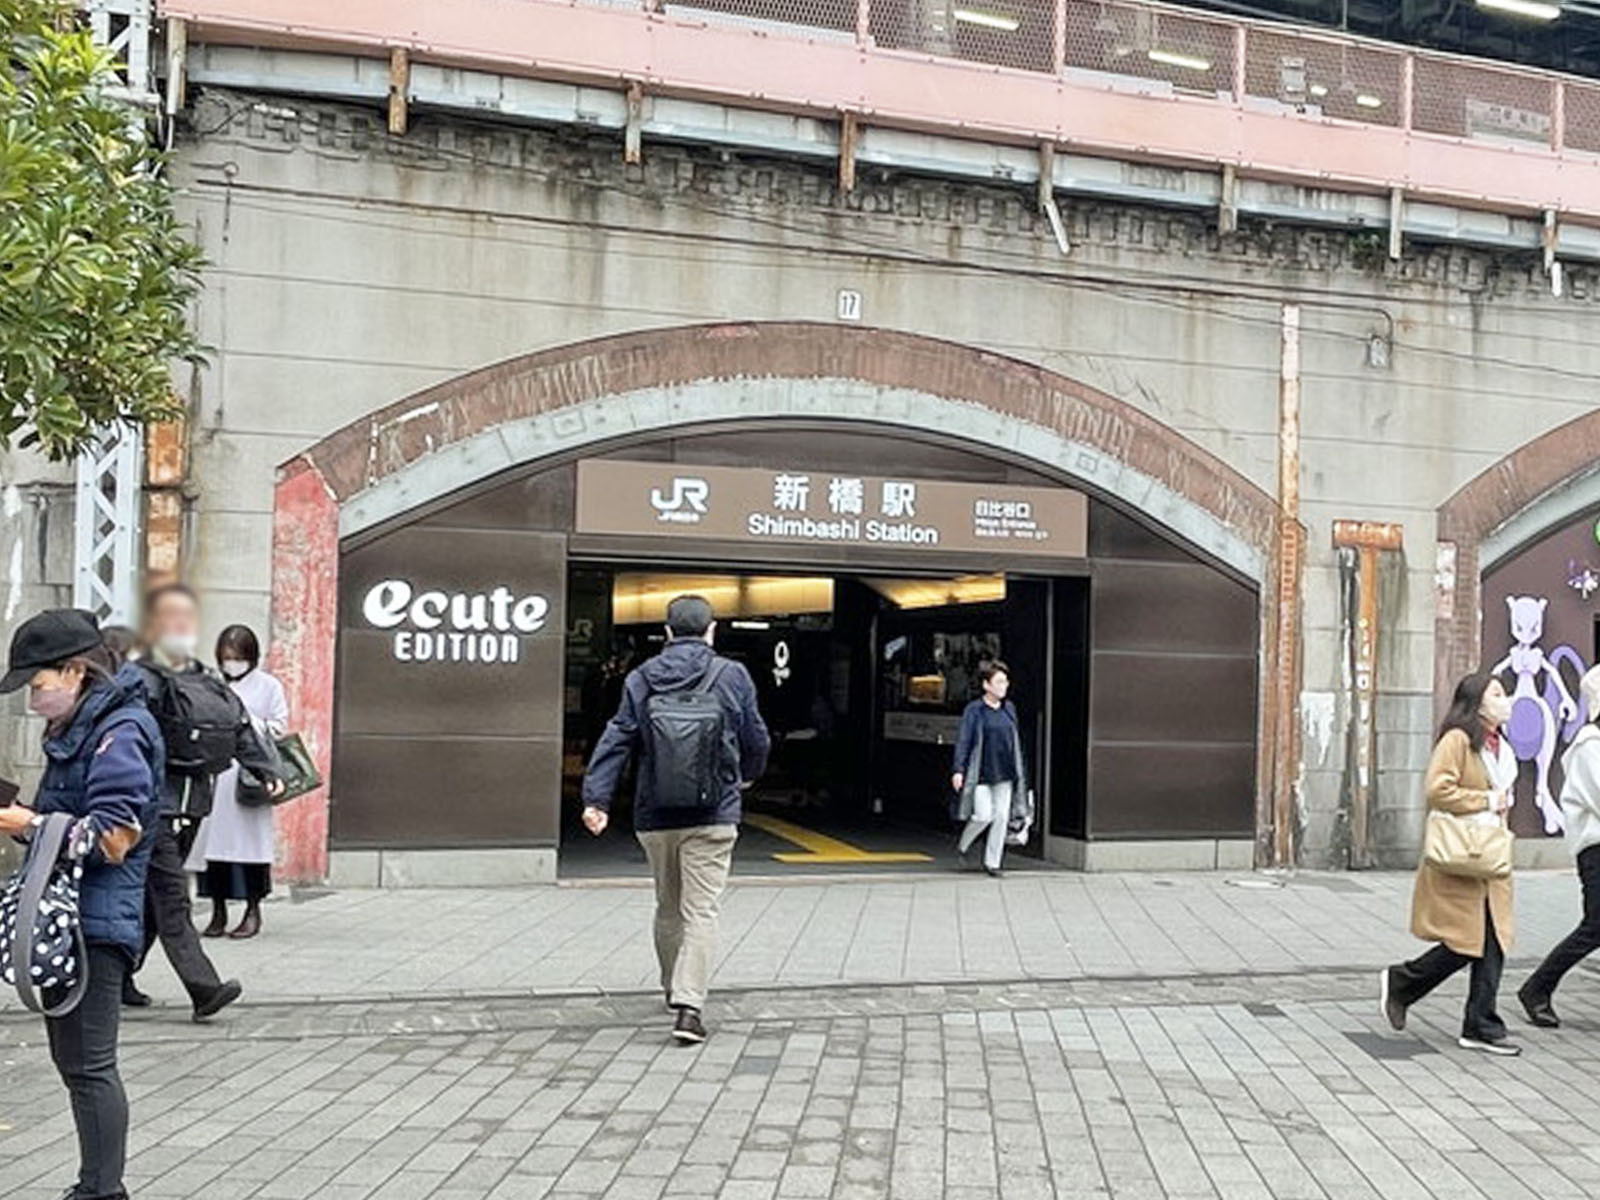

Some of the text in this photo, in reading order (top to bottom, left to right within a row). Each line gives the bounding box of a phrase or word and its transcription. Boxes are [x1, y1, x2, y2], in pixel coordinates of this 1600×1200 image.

[842, 294, 857, 315] 17
[651, 478, 708, 512] JR
[773, 474, 916, 517] 新橋駅
[748, 513, 938, 543] Shimbashi Station
[363, 580, 548, 632] ecute
[394, 632, 519, 662] EDITION
